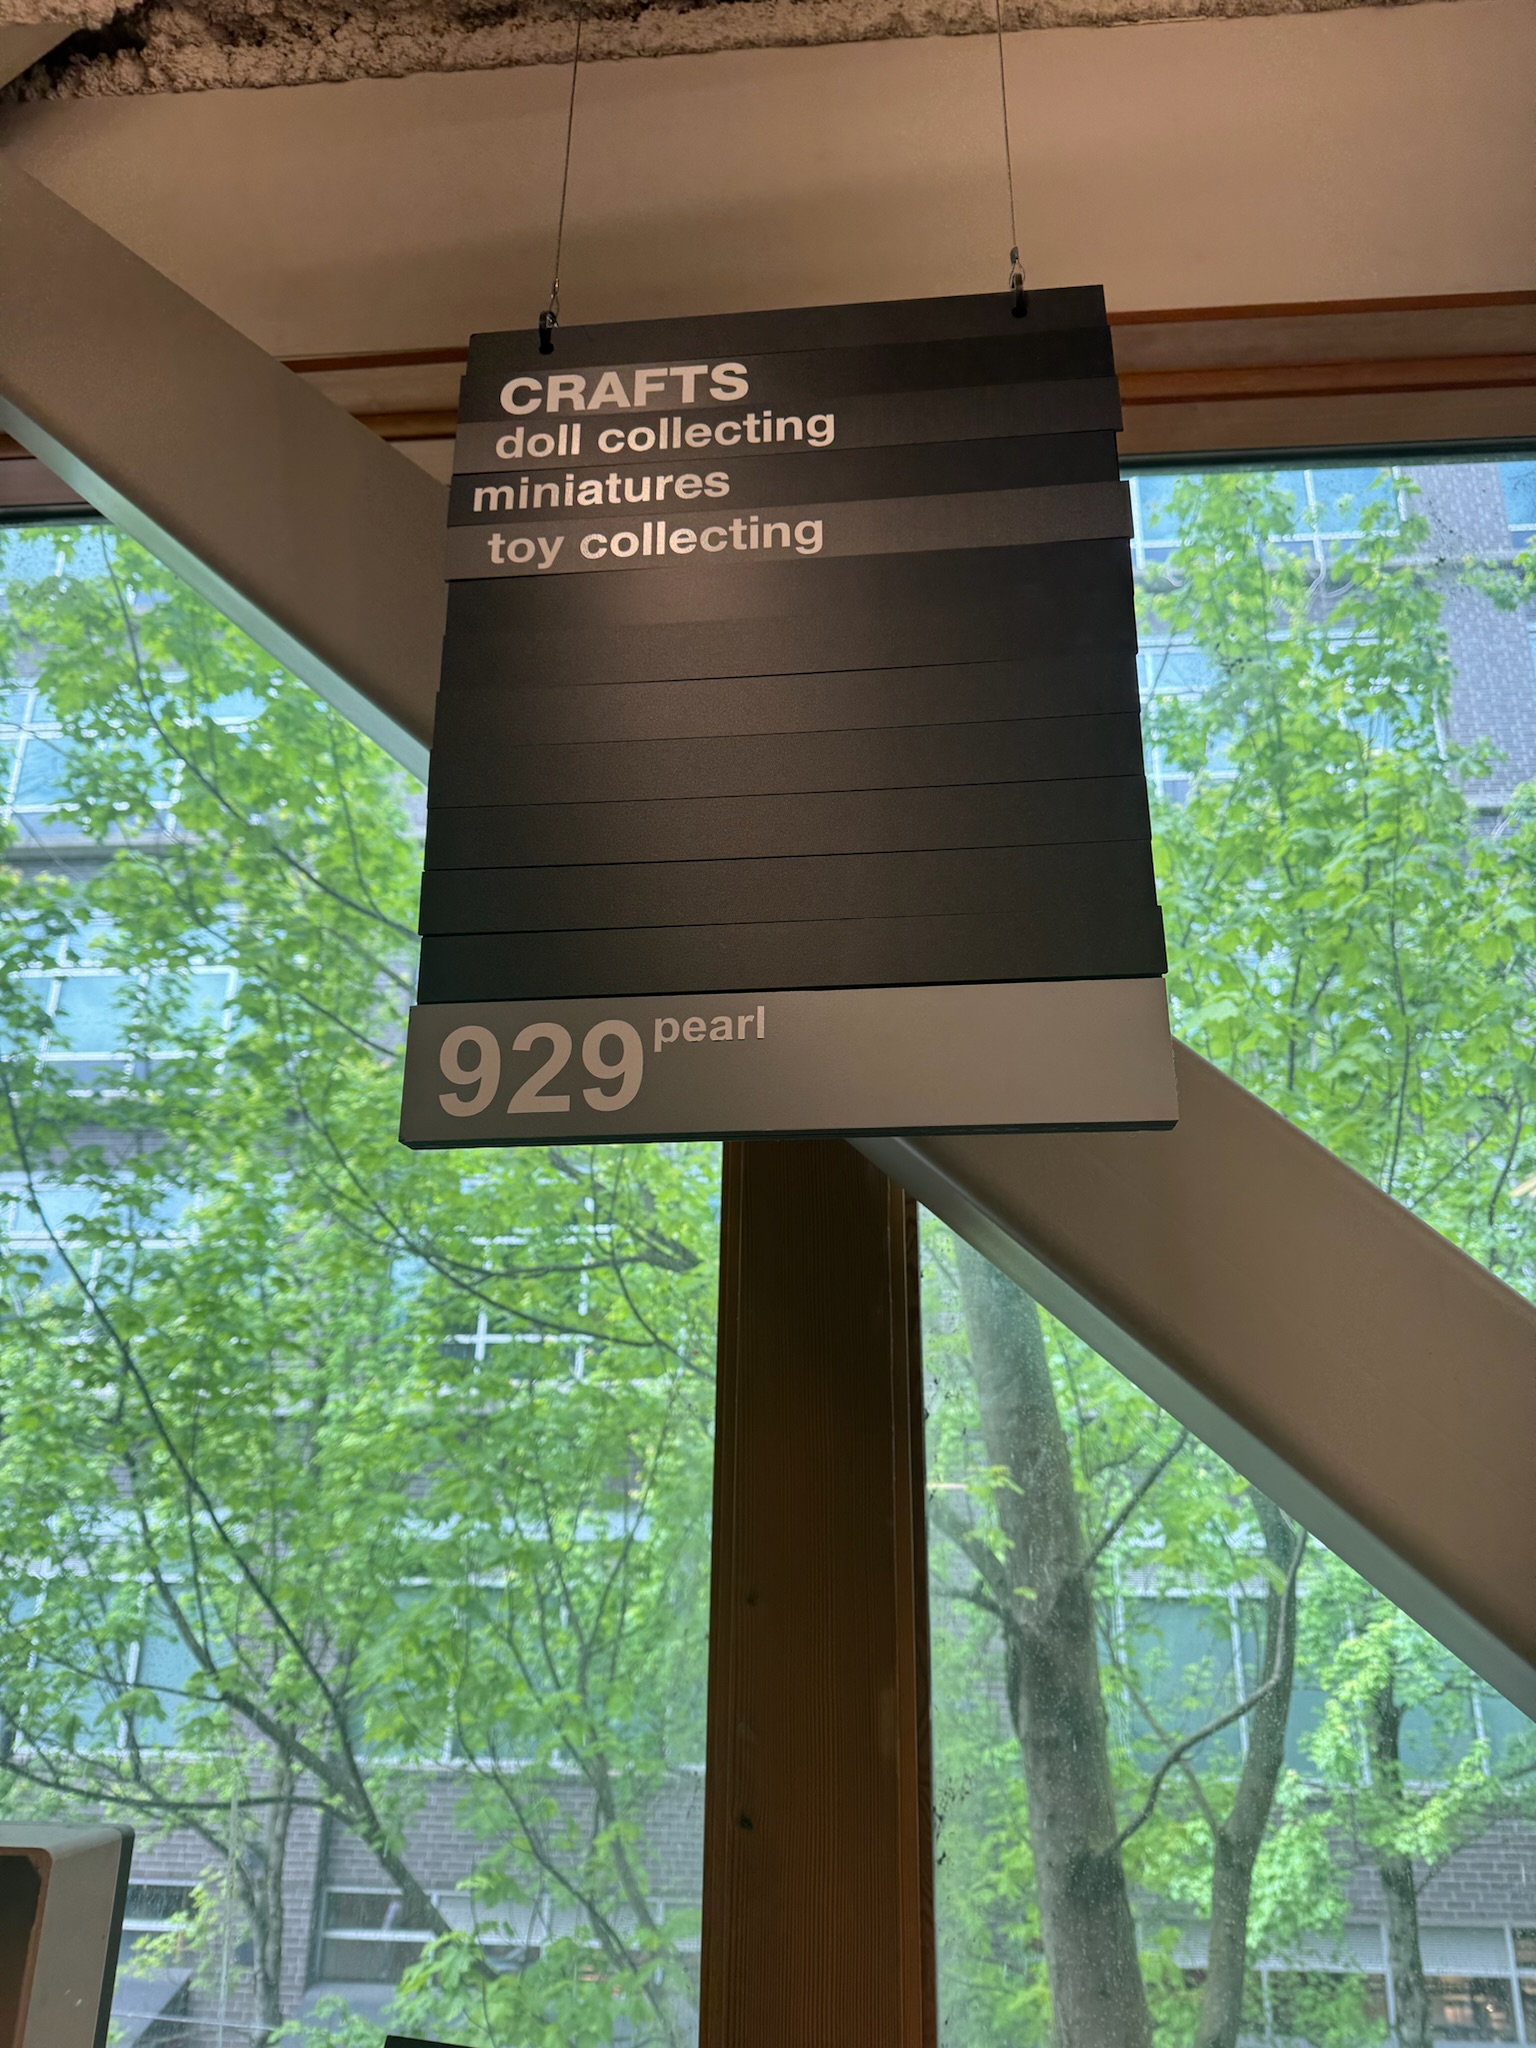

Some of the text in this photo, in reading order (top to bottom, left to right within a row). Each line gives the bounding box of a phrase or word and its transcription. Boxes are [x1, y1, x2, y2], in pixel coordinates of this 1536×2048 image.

[500, 362, 749, 415] CRAFTS
[495, 410, 835, 459] doll collecting
[473, 470, 731, 512] miniatures
[487, 515, 824, 570] toy collecting
[438, 1005, 766, 1118] 929 pearl
